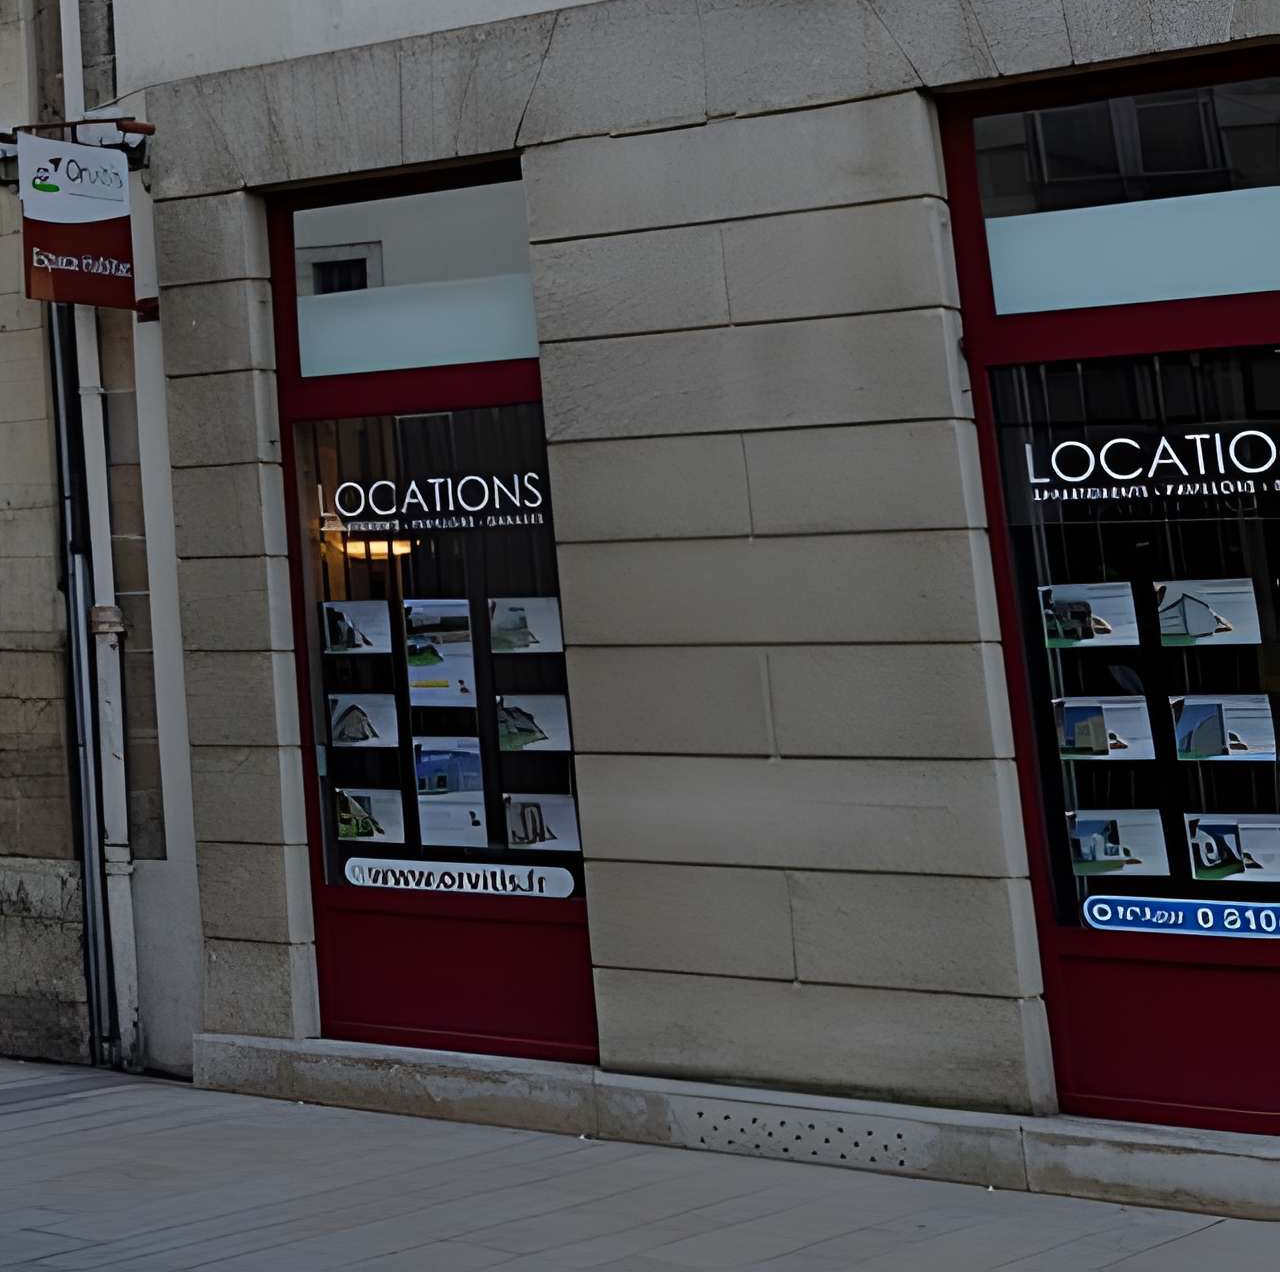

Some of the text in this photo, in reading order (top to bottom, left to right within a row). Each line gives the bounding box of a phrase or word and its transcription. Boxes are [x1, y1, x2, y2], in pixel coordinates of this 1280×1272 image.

[1024, 430, 1280, 484] LOCATIO
[317, 471, 543, 517] LOCATIONS
[1223, 908, 1280, 933] 810
